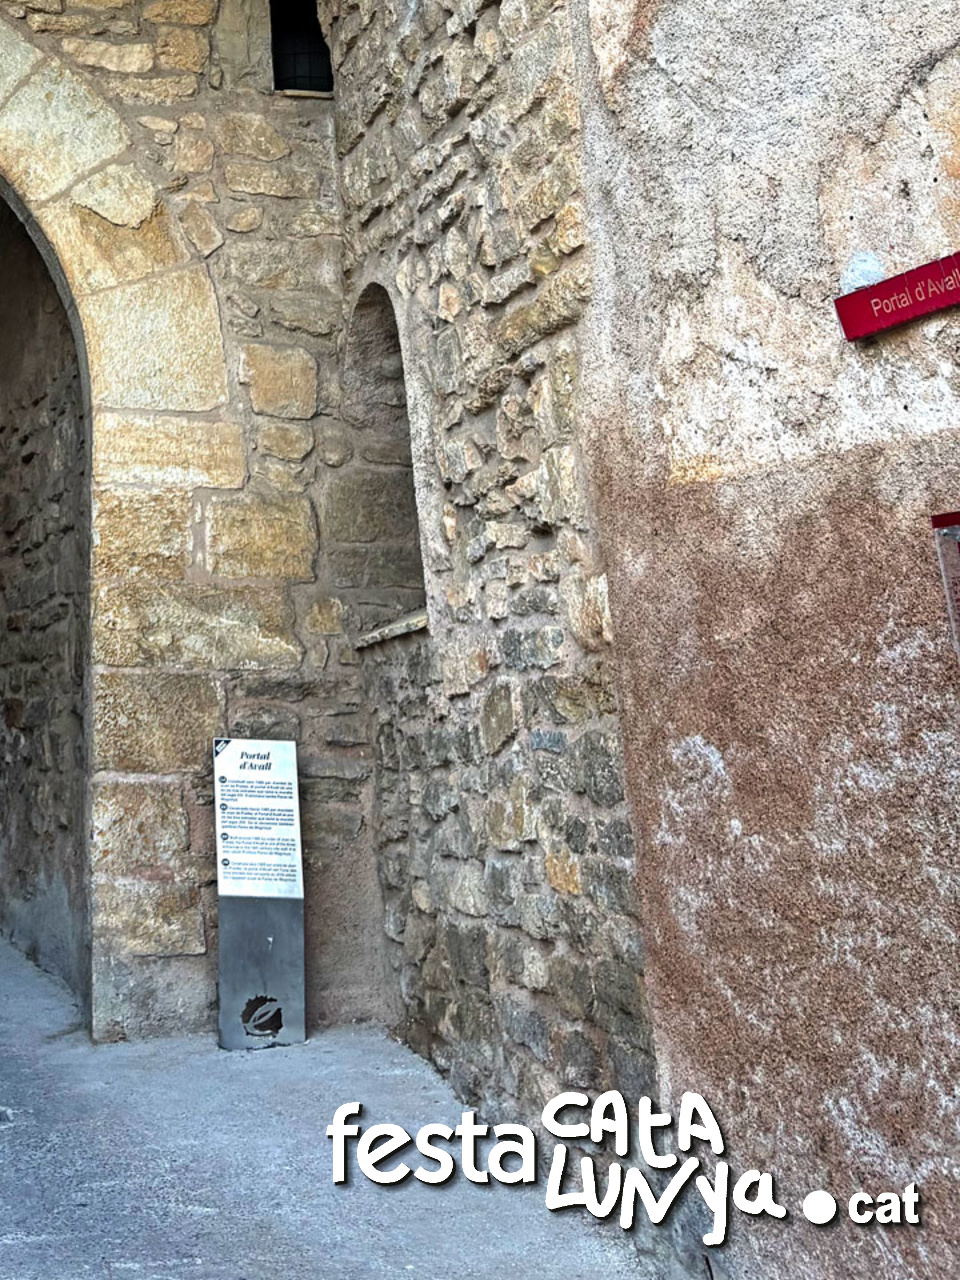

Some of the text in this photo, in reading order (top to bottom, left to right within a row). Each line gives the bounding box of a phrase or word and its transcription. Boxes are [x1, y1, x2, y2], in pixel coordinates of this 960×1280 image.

[870, 287, 913, 317] Portal
[240, 751, 271, 761] Portal
[239, 761, 272, 771] d'Avall
